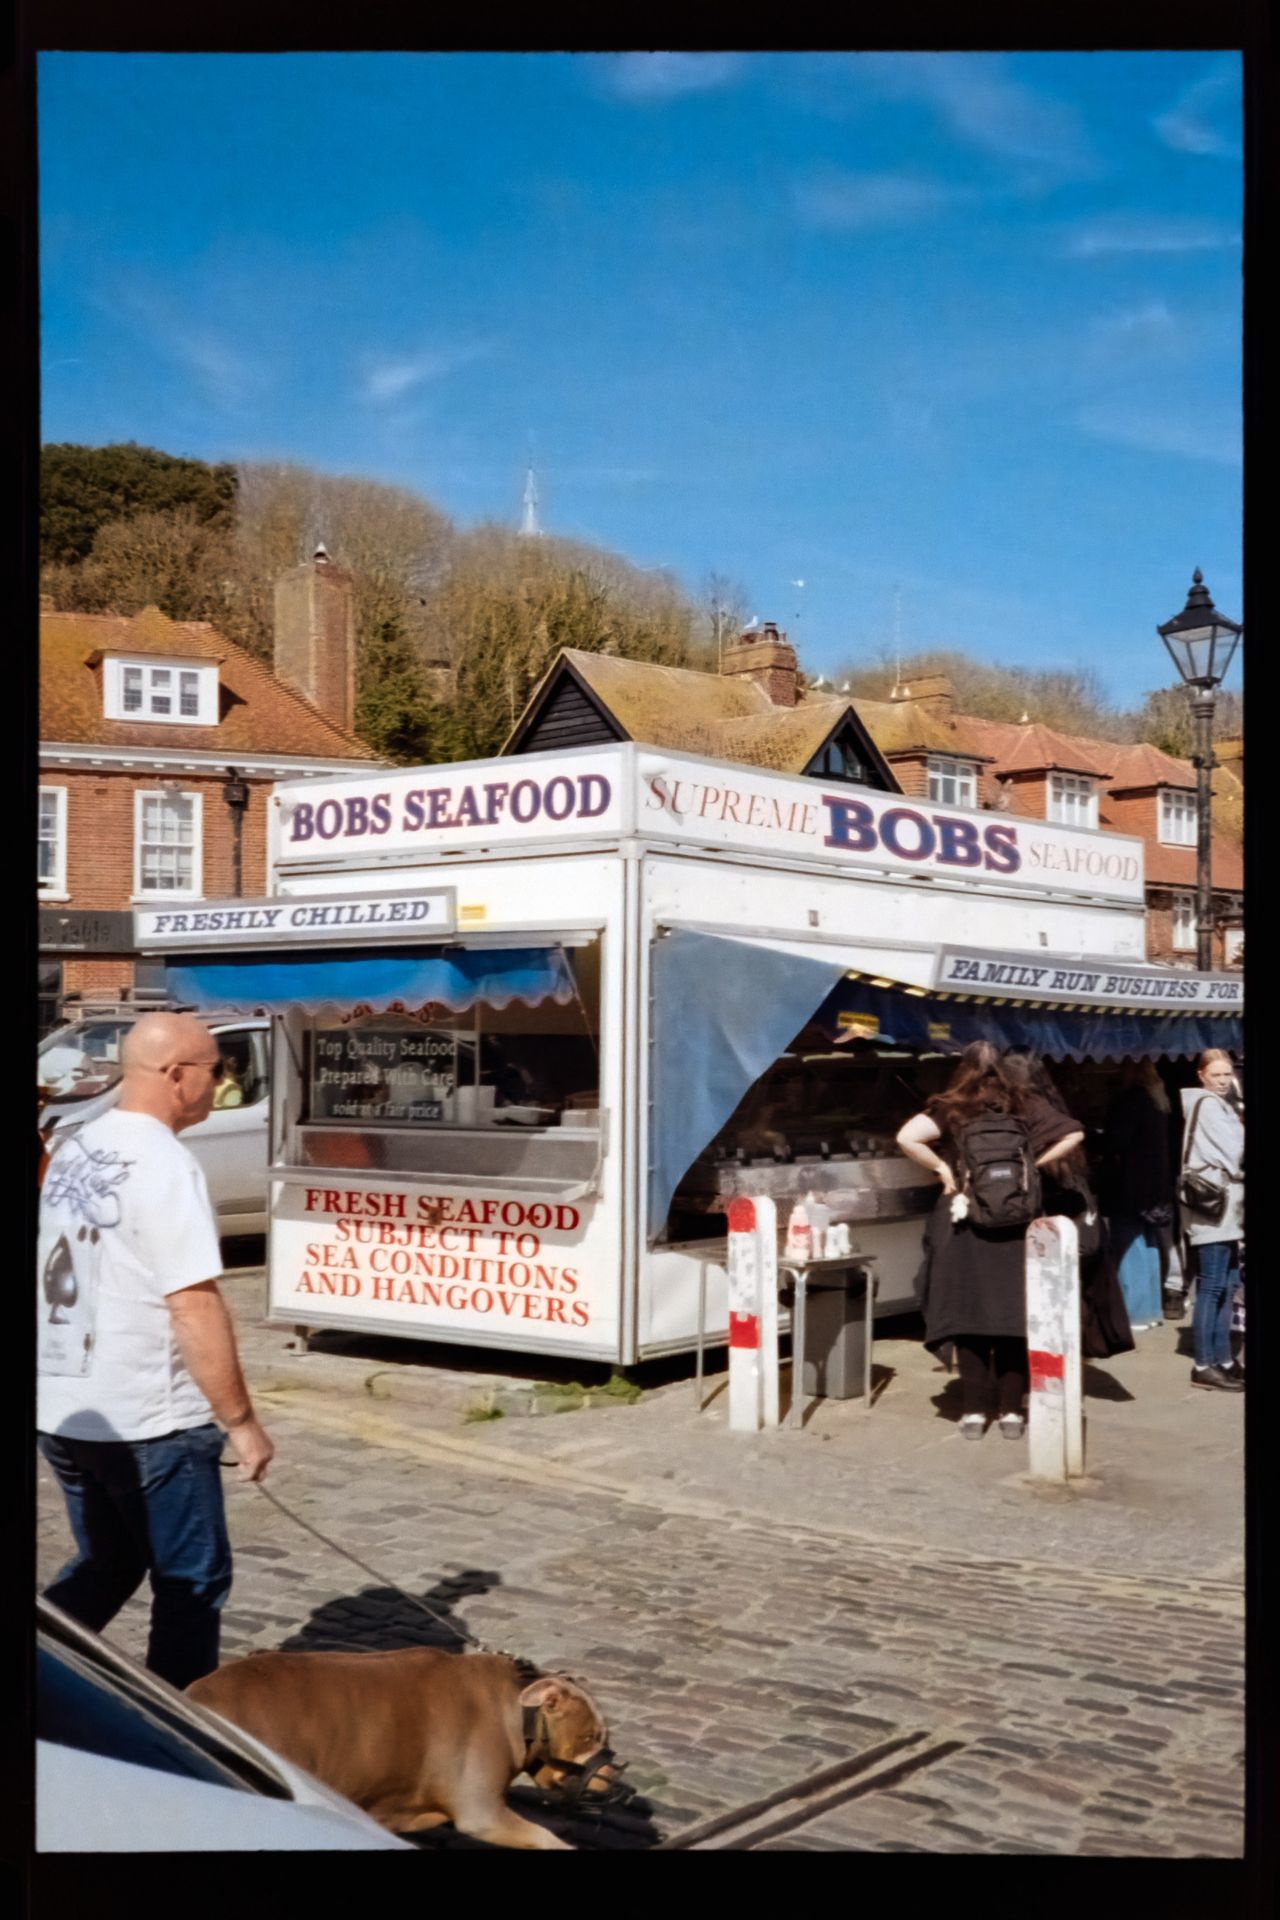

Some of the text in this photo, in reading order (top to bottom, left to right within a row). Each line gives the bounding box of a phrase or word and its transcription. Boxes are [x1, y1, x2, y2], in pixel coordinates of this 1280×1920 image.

[290, 774, 612, 842] BOBS SEAFOOD
[645, 775, 1139, 881] SUPREME BOBS SEAFOOD
[152, 900, 430, 933] FRESHLY CHILLED
[948, 959, 1239, 999] FAMILY RUN BUSINESS FOR
[318, 1036, 457, 1061] Top Quality Seafood
[320, 1064, 379, 1090] Prepared
[422, 1068, 456, 1087] Care
[408, 1102, 440, 1121] price
[304, 1188, 580, 1231] FRESH SEAFOOD
[335, 1218, 541, 1259] SUBJECT TO
[305, 1242, 579, 1294] SEA CONDITIONS
[295, 1271, 590, 1328] AND HANGOVERS
